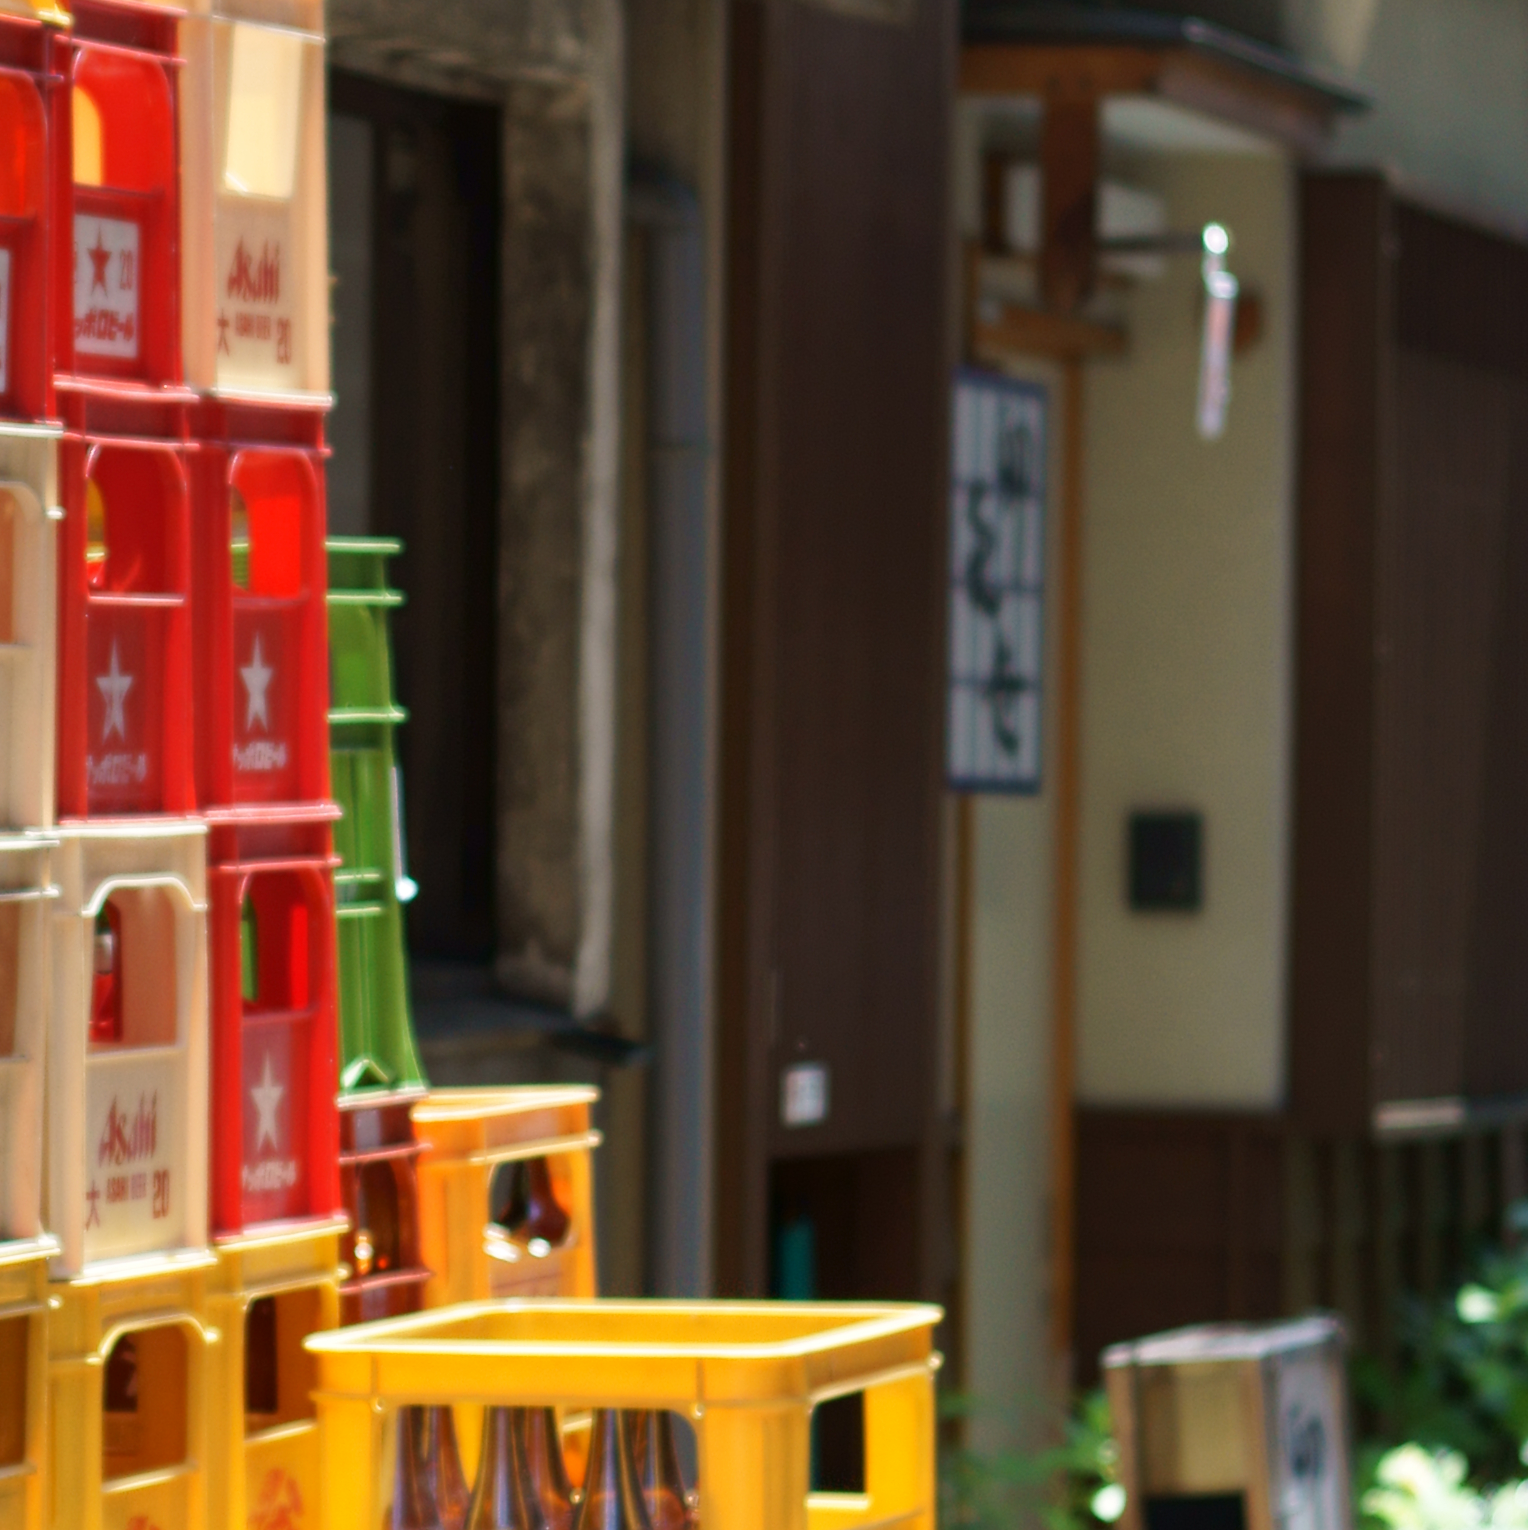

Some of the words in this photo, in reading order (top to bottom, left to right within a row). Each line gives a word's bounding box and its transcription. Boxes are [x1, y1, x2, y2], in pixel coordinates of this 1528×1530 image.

[76, 306, 134, 341] ッポロビール
[98, 1089, 158, 1167] Asahi
[152, 1169, 169, 1220] 20
